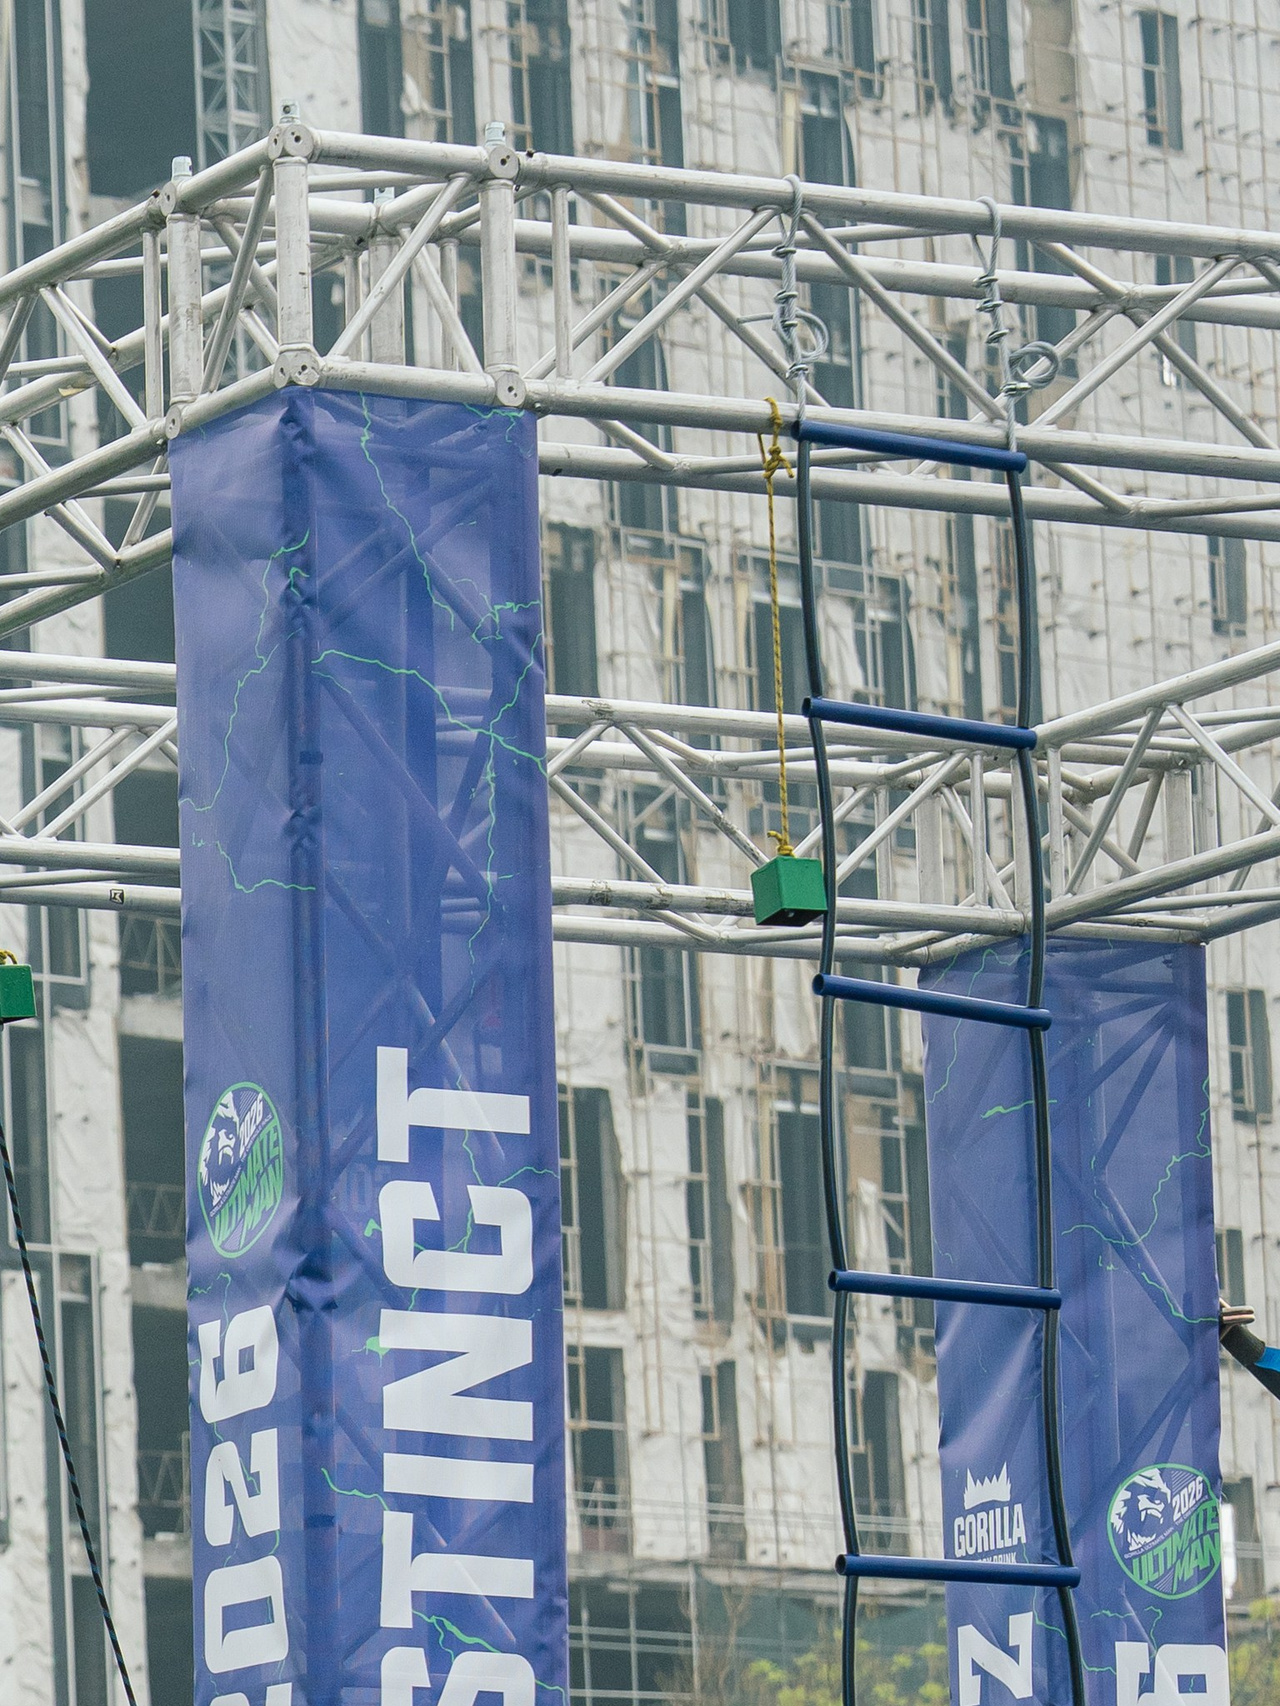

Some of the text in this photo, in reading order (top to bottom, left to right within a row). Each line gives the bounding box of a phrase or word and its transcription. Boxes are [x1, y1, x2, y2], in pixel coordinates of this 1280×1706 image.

[239, 1092, 264, 1159] 2026
[1171, 1474, 1205, 1523] 2026
[953, 1502, 1027, 1558] GORILLA
